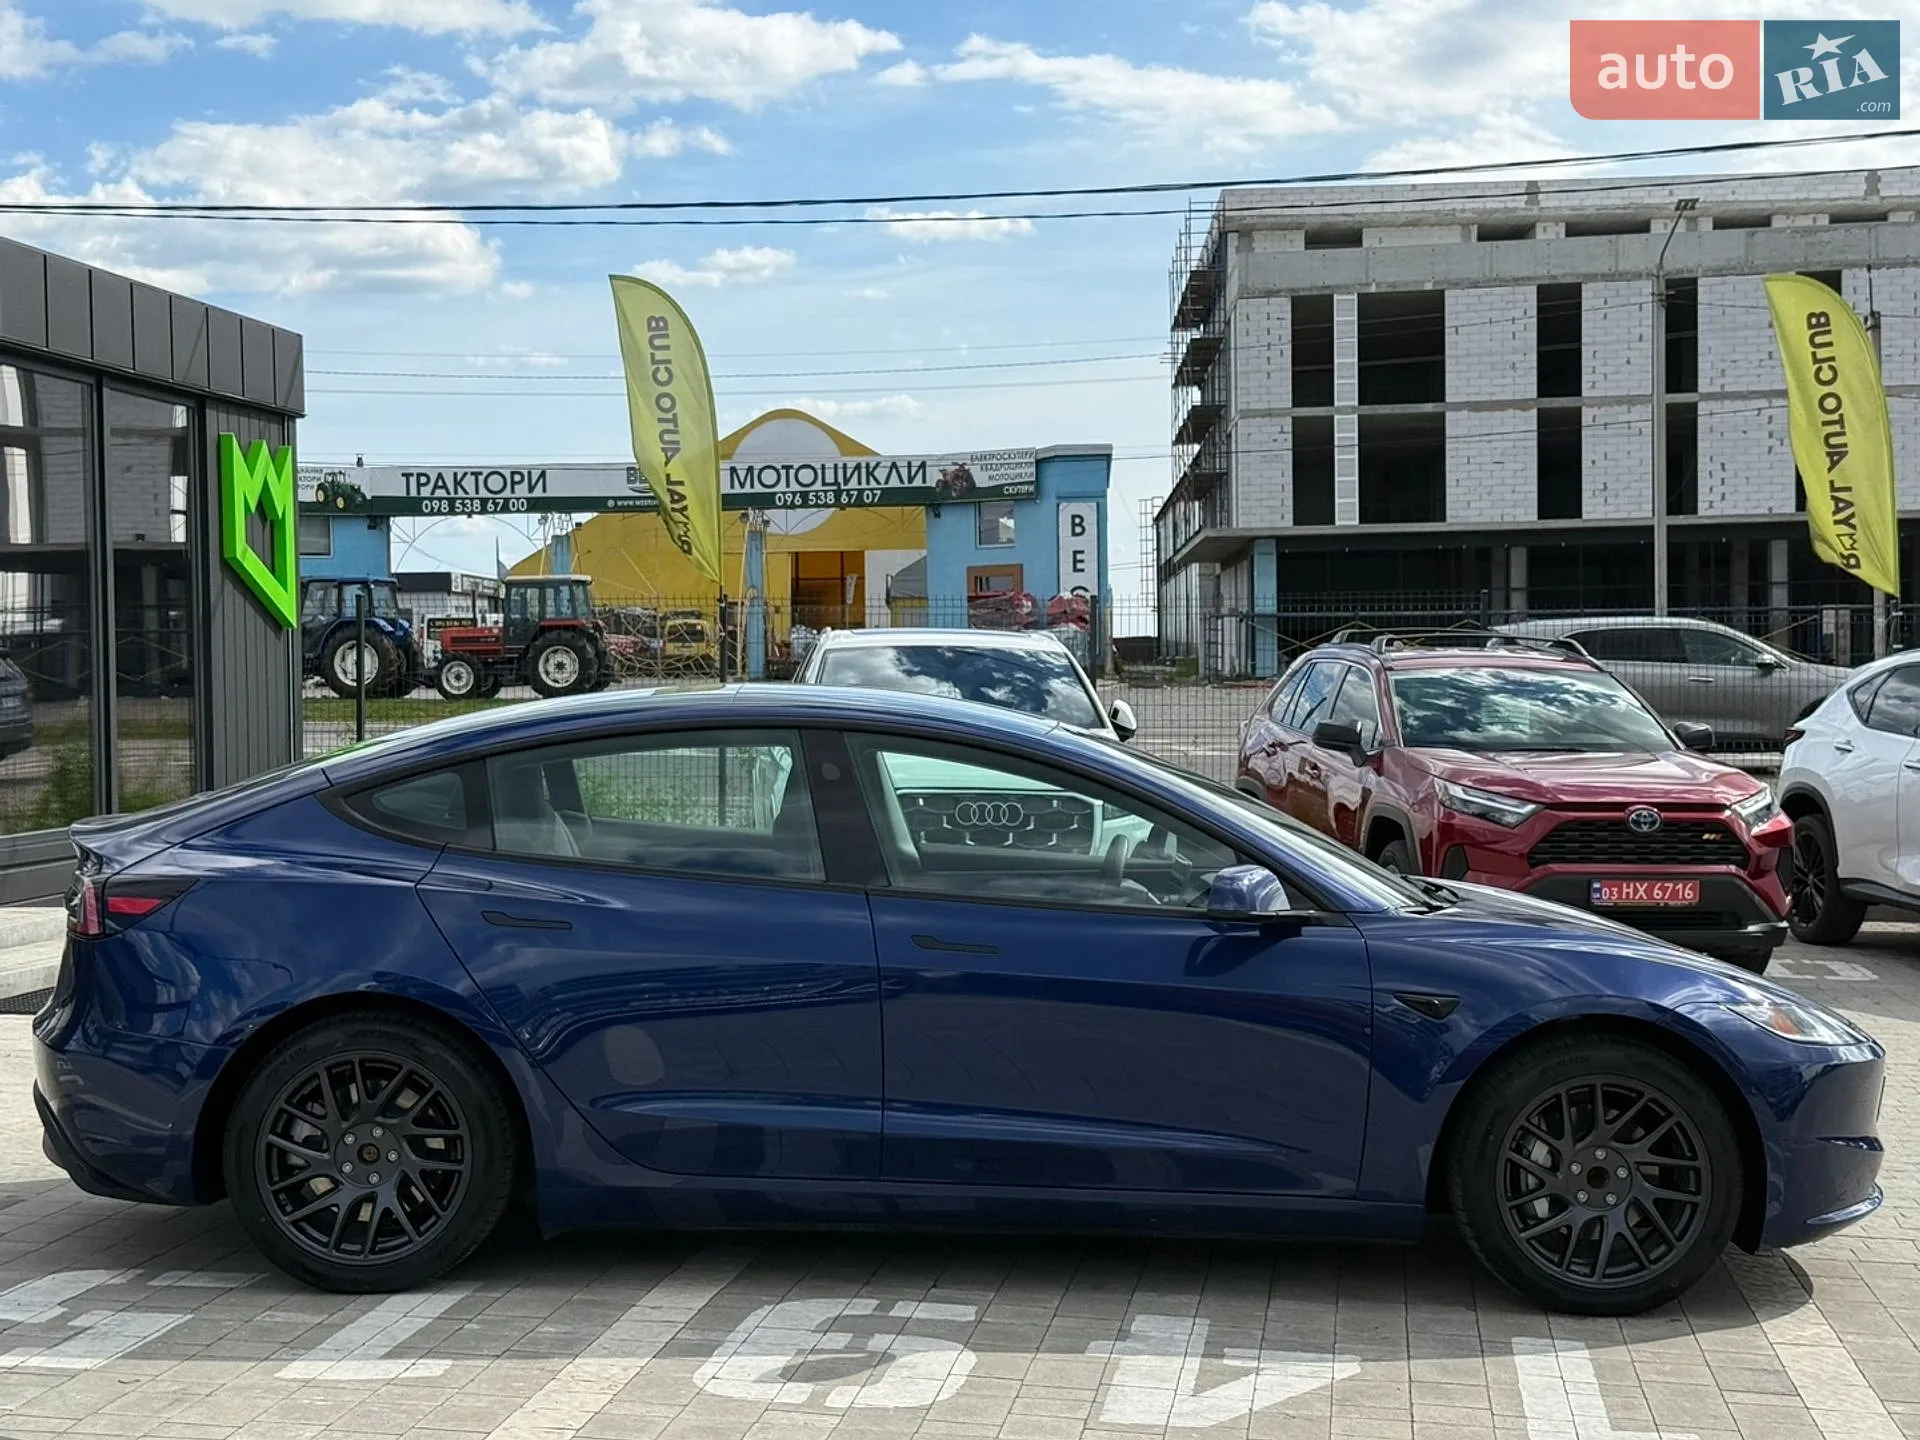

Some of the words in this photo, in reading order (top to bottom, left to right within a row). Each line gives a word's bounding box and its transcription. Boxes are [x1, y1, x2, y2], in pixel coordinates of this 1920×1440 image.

[401, 470, 548, 496] ТРАКТОРИ
[729, 460, 927, 489] МОТОЦИКЛИ
[422, 500, 450, 513] 098
[454, 499, 482, 512] 538
[486, 499, 504, 512] 67
[509, 498, 527, 511] 00
[775, 493, 803, 506] 096
[808, 491, 835, 504] 538
[840, 491, 858, 504] 67
[863, 490, 882, 503] 07
[1601, 887, 1619, 900] 03
[1622, 882, 1648, 900] HX
[1653, 882, 1694, 900] 6716
